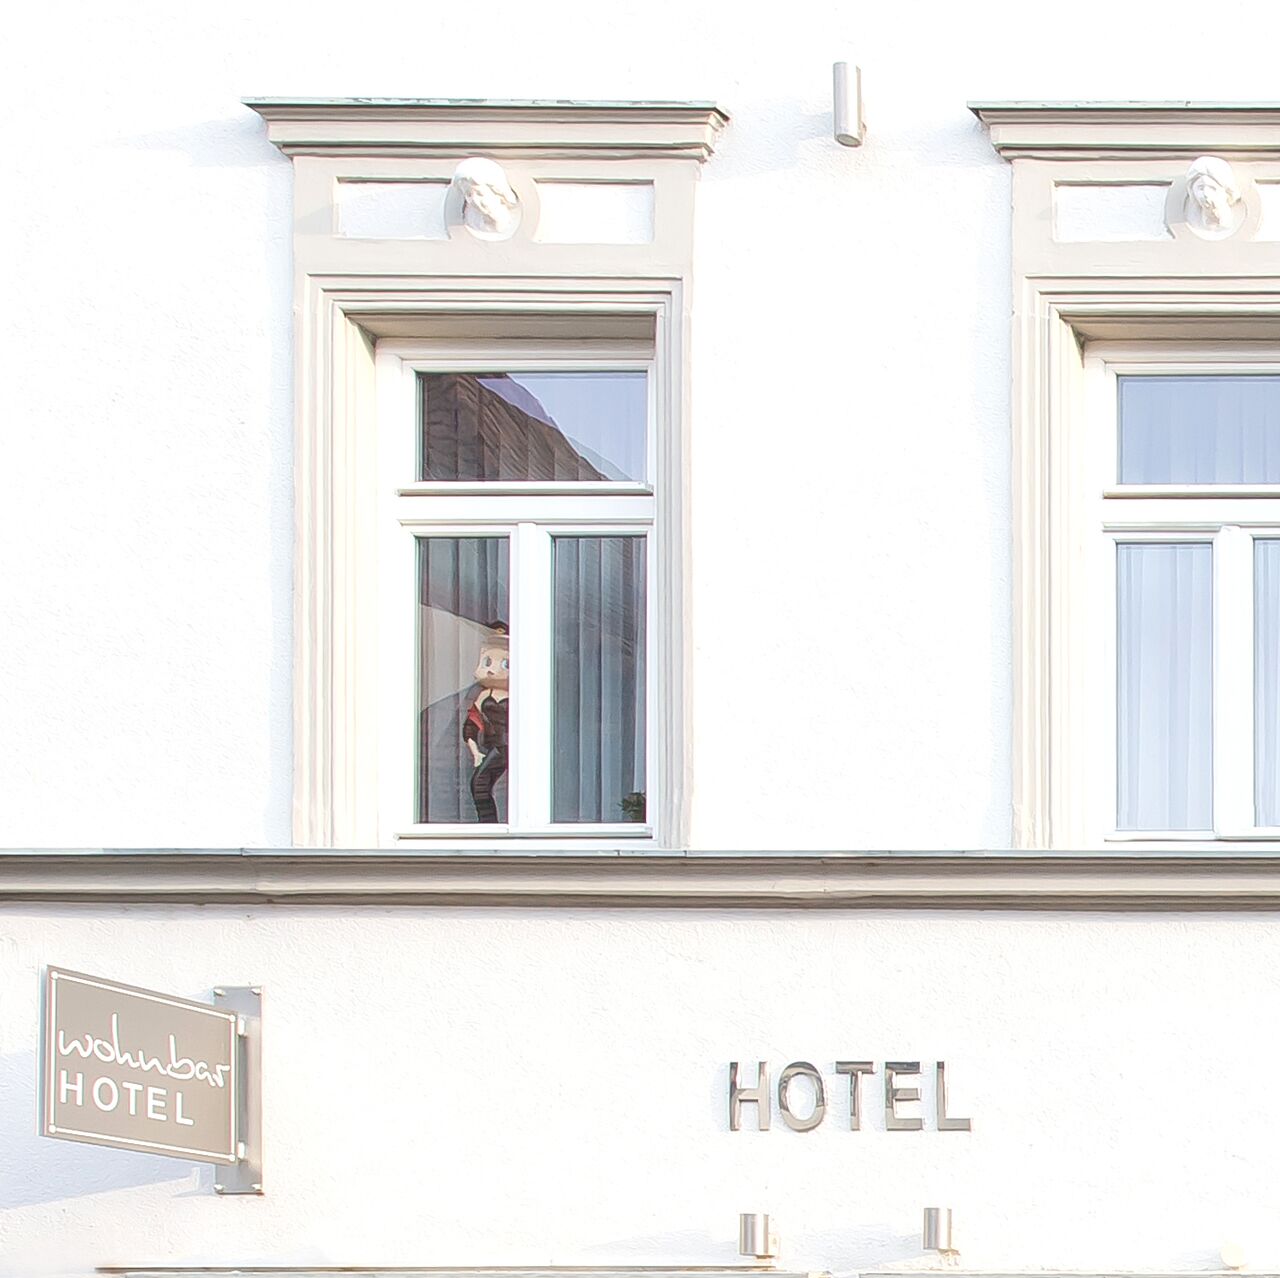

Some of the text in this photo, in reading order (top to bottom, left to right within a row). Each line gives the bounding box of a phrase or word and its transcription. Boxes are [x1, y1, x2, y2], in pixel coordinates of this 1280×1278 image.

[58, 1012, 230, 1088] wohnbar
[59, 1069, 194, 1126] HOTEL
[728, 1061, 971, 1132] HOTEL
